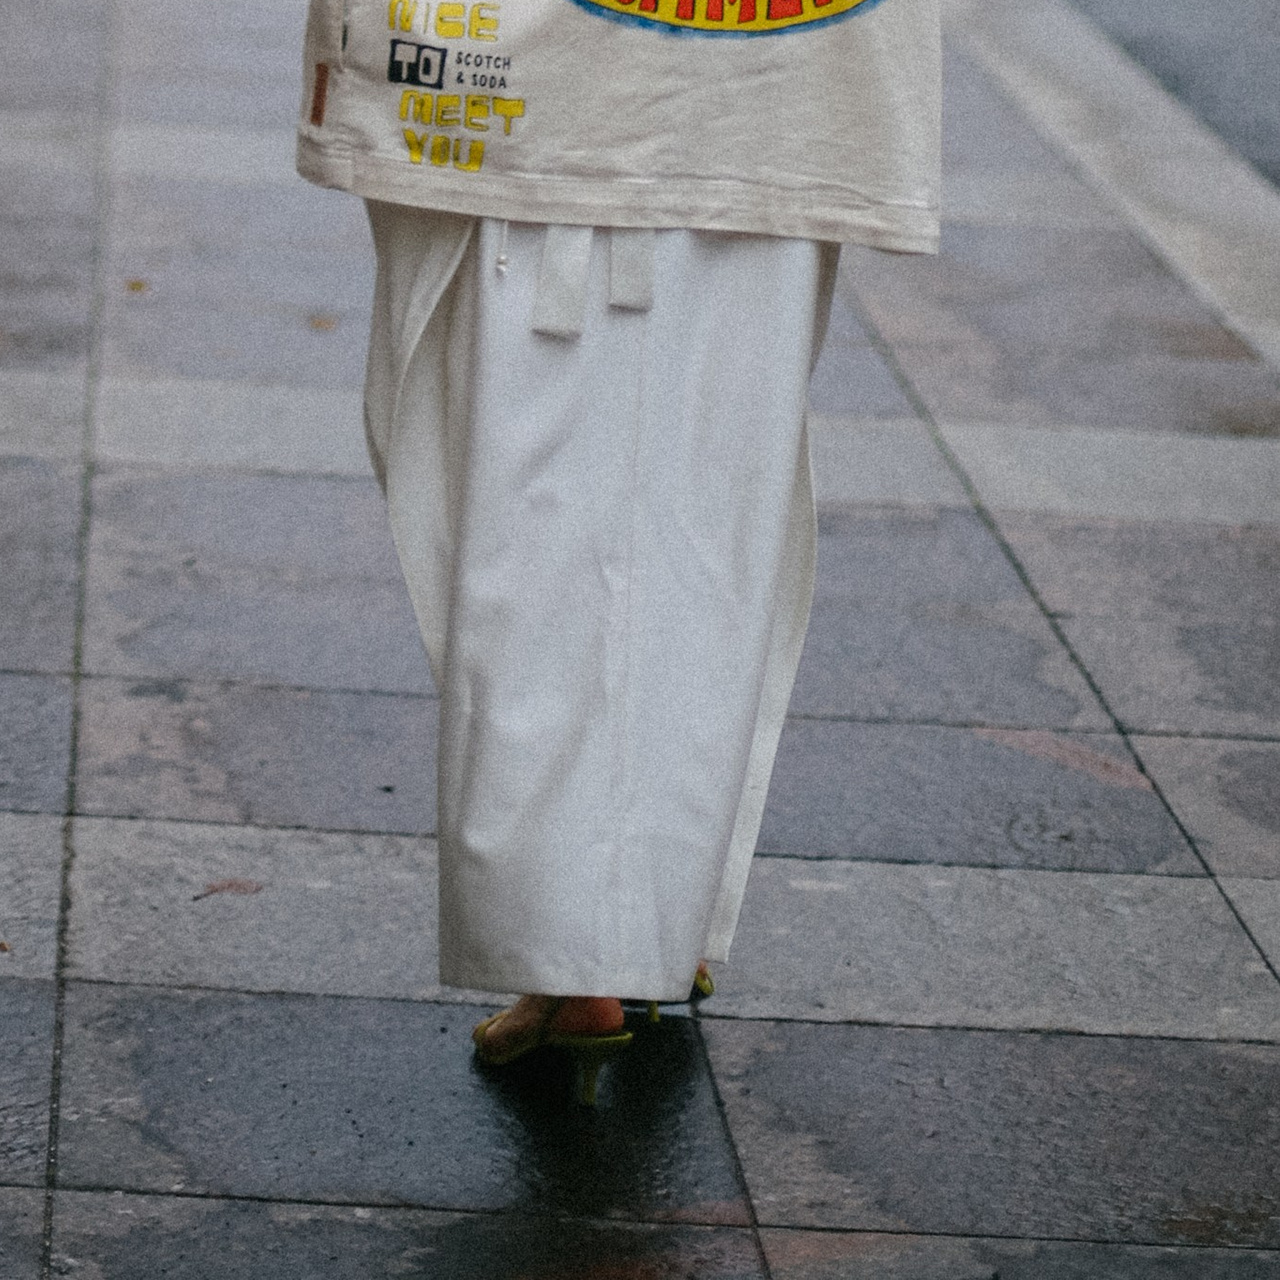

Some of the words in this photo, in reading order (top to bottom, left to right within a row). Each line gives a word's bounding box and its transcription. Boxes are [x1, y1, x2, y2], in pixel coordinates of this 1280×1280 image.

[394, 43, 446, 87] TO
[455, 51, 511, 70] SCOTCH
[456, 71, 464, 84] &
[471, 73, 507, 88] SODA
[399, 90, 525, 136] MEET
[402, 128, 486, 172] YOU
